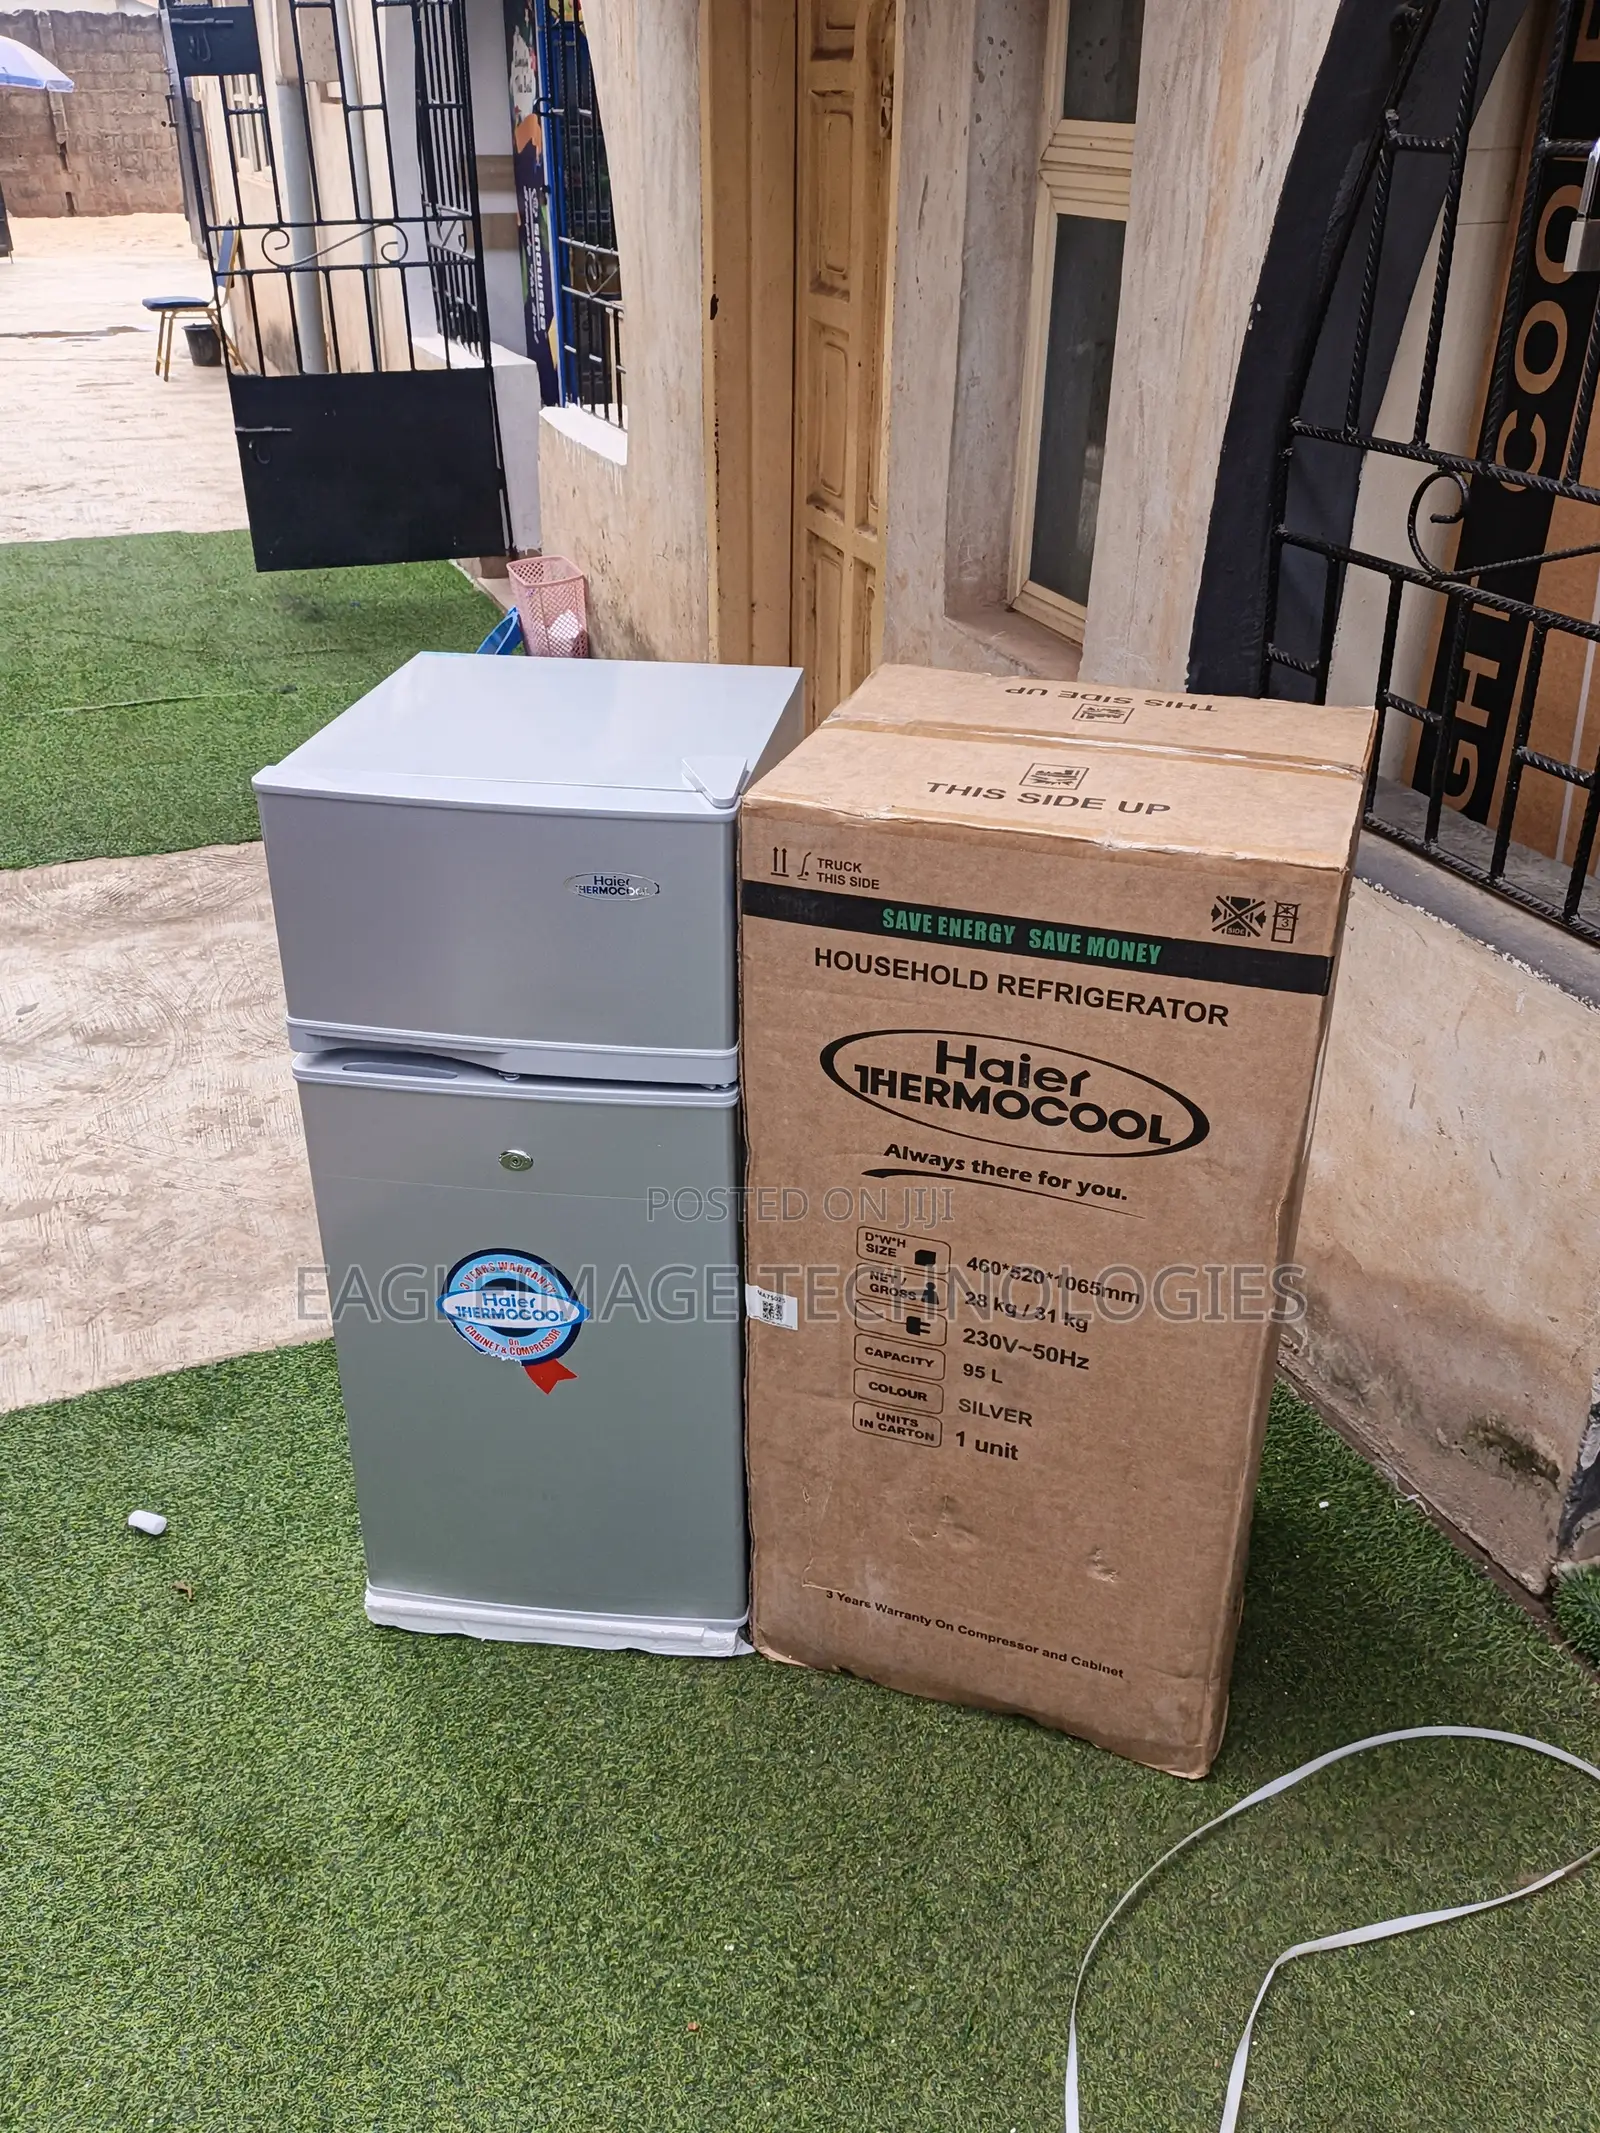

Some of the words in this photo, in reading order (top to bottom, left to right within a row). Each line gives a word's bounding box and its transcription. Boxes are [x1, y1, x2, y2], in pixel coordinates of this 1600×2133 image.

[1496, 156, 1600, 493] COO
[1005, 686, 1050, 698] UP
[1059, 690, 1134, 705] SIDE
[1144, 698, 1219, 712] THIS
[926, 781, 1007, 801] THIS
[1018, 789, 1106, 811] SIDE
[1116, 801, 1171, 816] UP
[817, 858, 862, 873] TRUCK
[593, 876, 630, 886] Haier
[816, 873, 847, 887] THIS
[849, 876, 880, 891] SIDE
[1228, 927, 1245, 935] SIDE
[1281, 918, 1290, 927] 3
[882, 908, 932, 936] SAVE
[937, 916, 1016, 946] ENERGY
[1028, 929, 1082, 955] SAVE
[1086, 937, 1163, 966] MONEY
[815, 947, 988, 991] HOUSEHOLD
[997, 974, 1229, 1026] REFRIGERATOR
[935, 1040, 1091, 1097] Haier
[854, 1065, 1172, 1146] THERMOCOOL
[883, 1143, 965, 1173] Always
[971, 1158, 1032, 1183] there
[1039, 1170, 1072, 1190] for
[1076, 1180, 1128, 1202] you.
[866, 1243, 897, 1258] SIZE
[458, 1281, 470, 1291] 3
[464, 1263, 496, 1282] YEARS
[498, 1261, 557, 1294] WARRANTY
[869, 1269, 898, 1283] NET
[482, 1293, 536, 1309] Haier
[869, 1282, 917, 1301] GROSS
[455, 1306, 568, 1322] THERMOCOOL
[964, 1291, 984, 1310] 28
[993, 1300, 1017, 1318] kg
[1022, 1306, 1030, 1319] /
[1034, 1305, 1056, 1325] 31
[1063, 1312, 1089, 1333] kg
[464, 1325, 499, 1352] CABINET
[501, 1346, 508, 1354] &
[509, 1329, 562, 1356] COMPRESSOR
[508, 1338, 520, 1347] On
[962, 1328, 1091, 1370] 230V~50Hz
[864, 1346, 935, 1368] CAPACITY
[963, 1363, 986, 1381] 95
[991, 1369, 1003, 1384] L
[868, 1381, 928, 1402] COLOUR
[876, 1412, 919, 1428] UNITS
[958, 1398, 1033, 1428] SILVER
[859, 1418, 874, 1429] IN
[877, 1422, 935, 1442] CARTON
[955, 1432, 966, 1448] 1
[974, 1439, 1019, 1462] unit
[826, 1589, 834, 1600] 3
[836, 1592, 872, 1610] Years
[875, 1602, 933, 1628] Warranty
[935, 1618, 955, 1633] On
[957, 1624, 1040, 1656] Compressor
[1041, 1648, 1068, 1664] and
[1070, 1655, 1125, 1680] Cabinet
